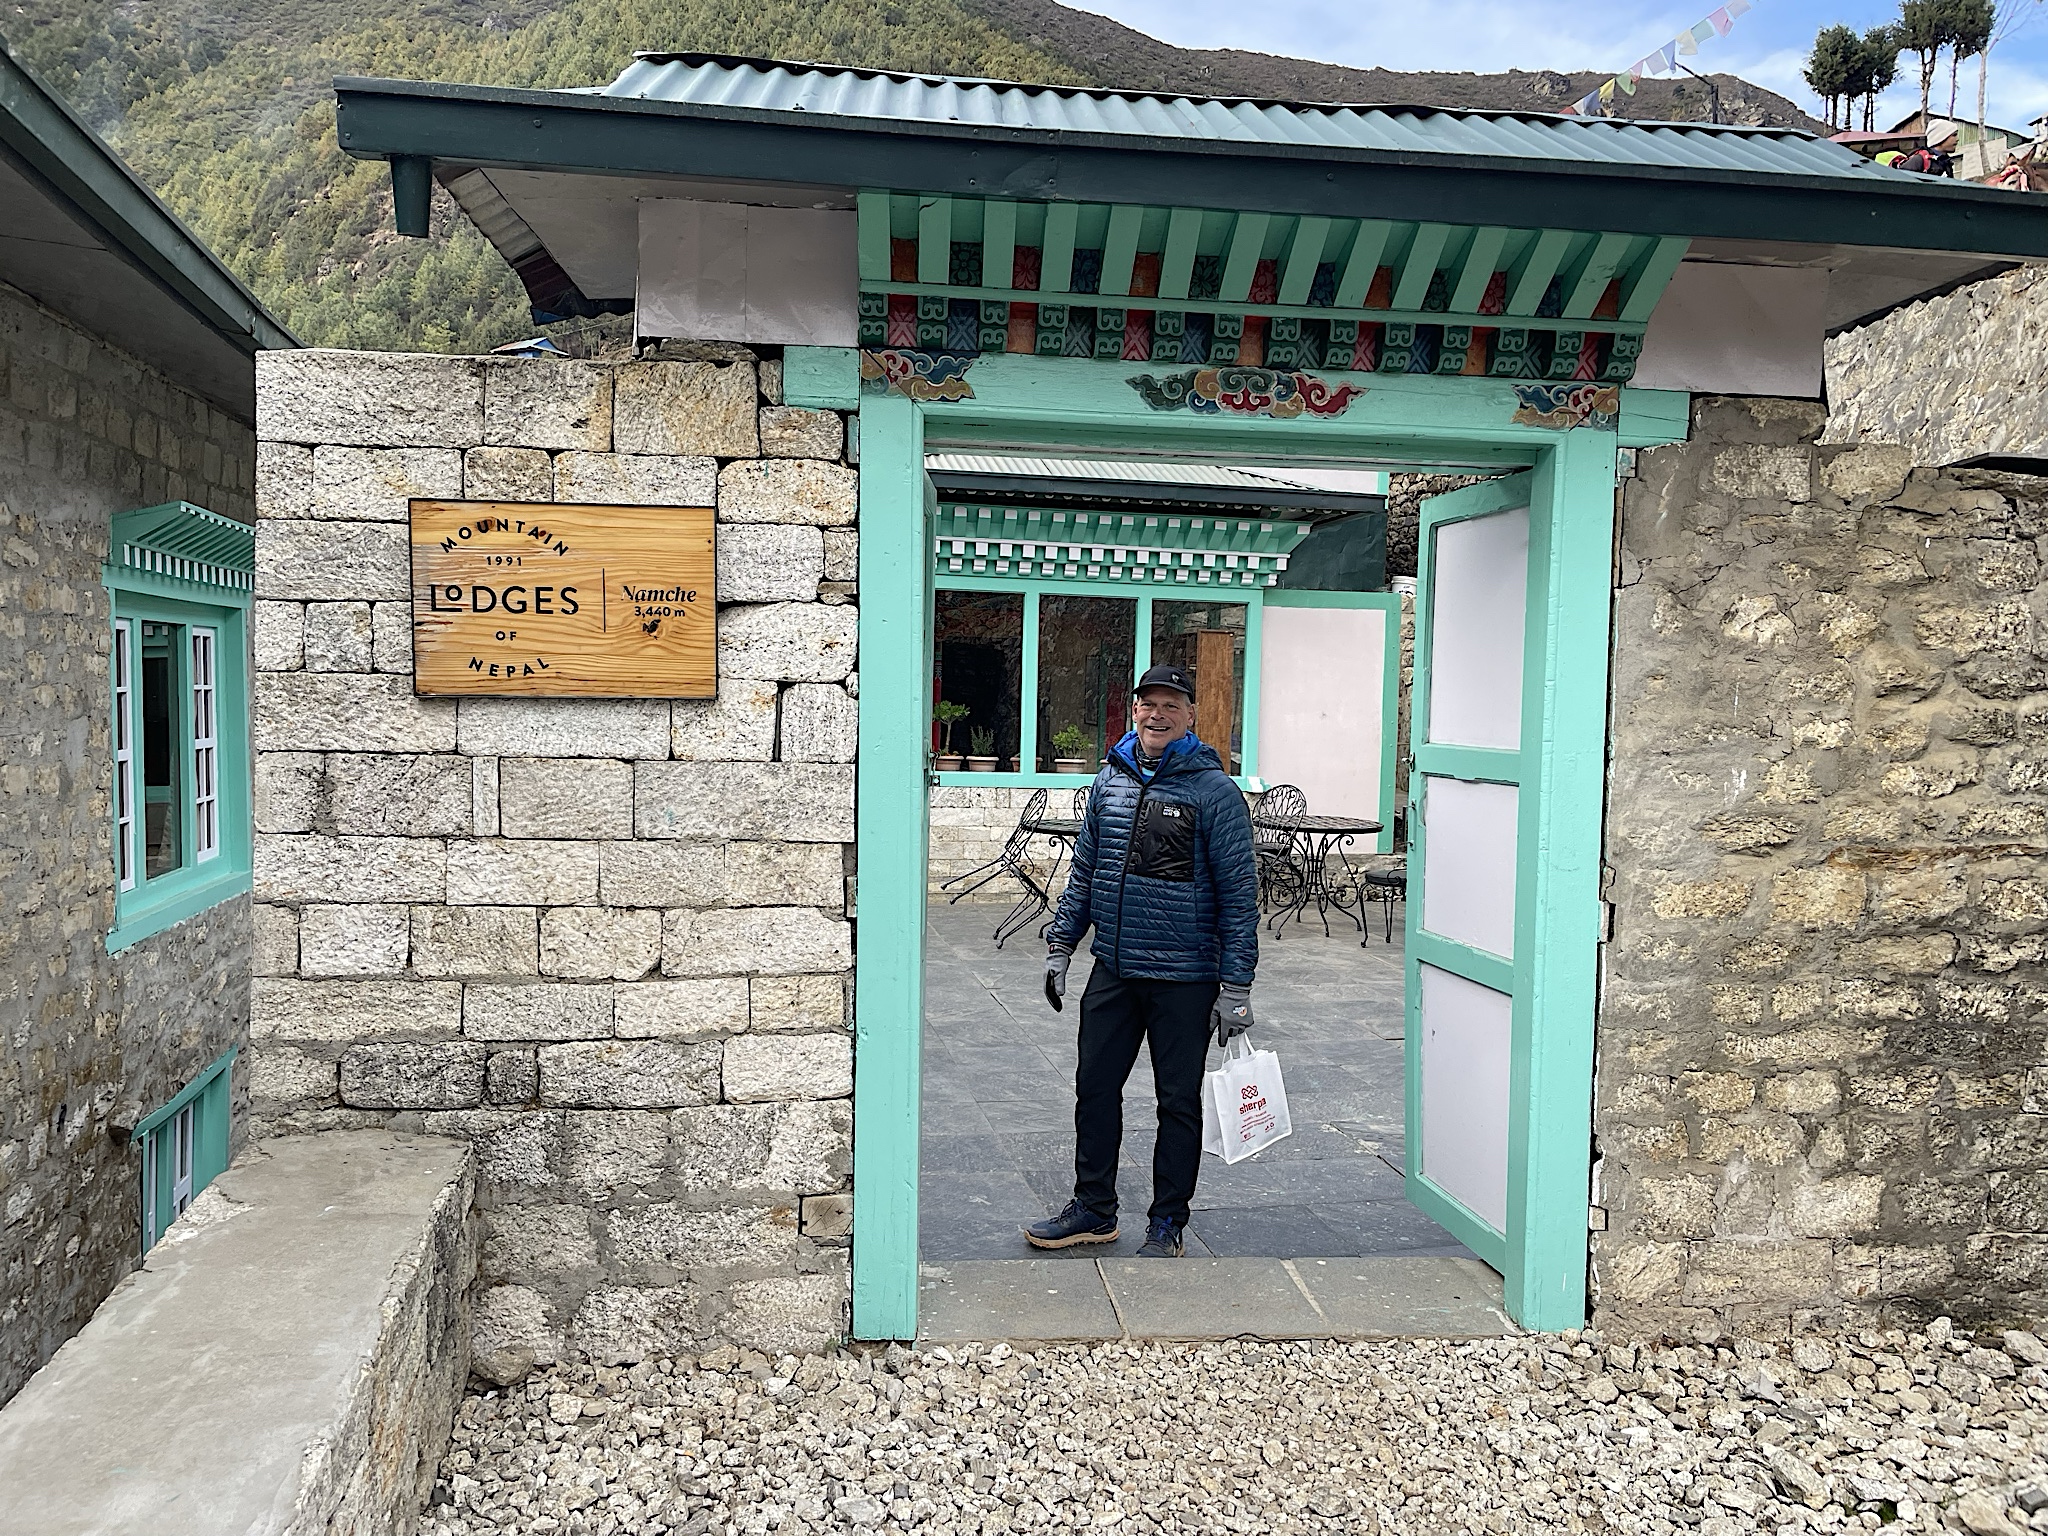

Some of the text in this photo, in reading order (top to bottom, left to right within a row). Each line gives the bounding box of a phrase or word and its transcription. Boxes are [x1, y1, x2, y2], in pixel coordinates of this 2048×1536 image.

[440, 518, 569, 556] MOUNTAIN
[486, 556, 522, 566] 1991
[621, 585, 697, 603] Namche
[634, 606, 686, 618] 3,440 m
[495, 631, 517, 641] OF
[468, 656, 550, 677] NEPAL
[1239, 1097, 1267, 1114] sherpa
